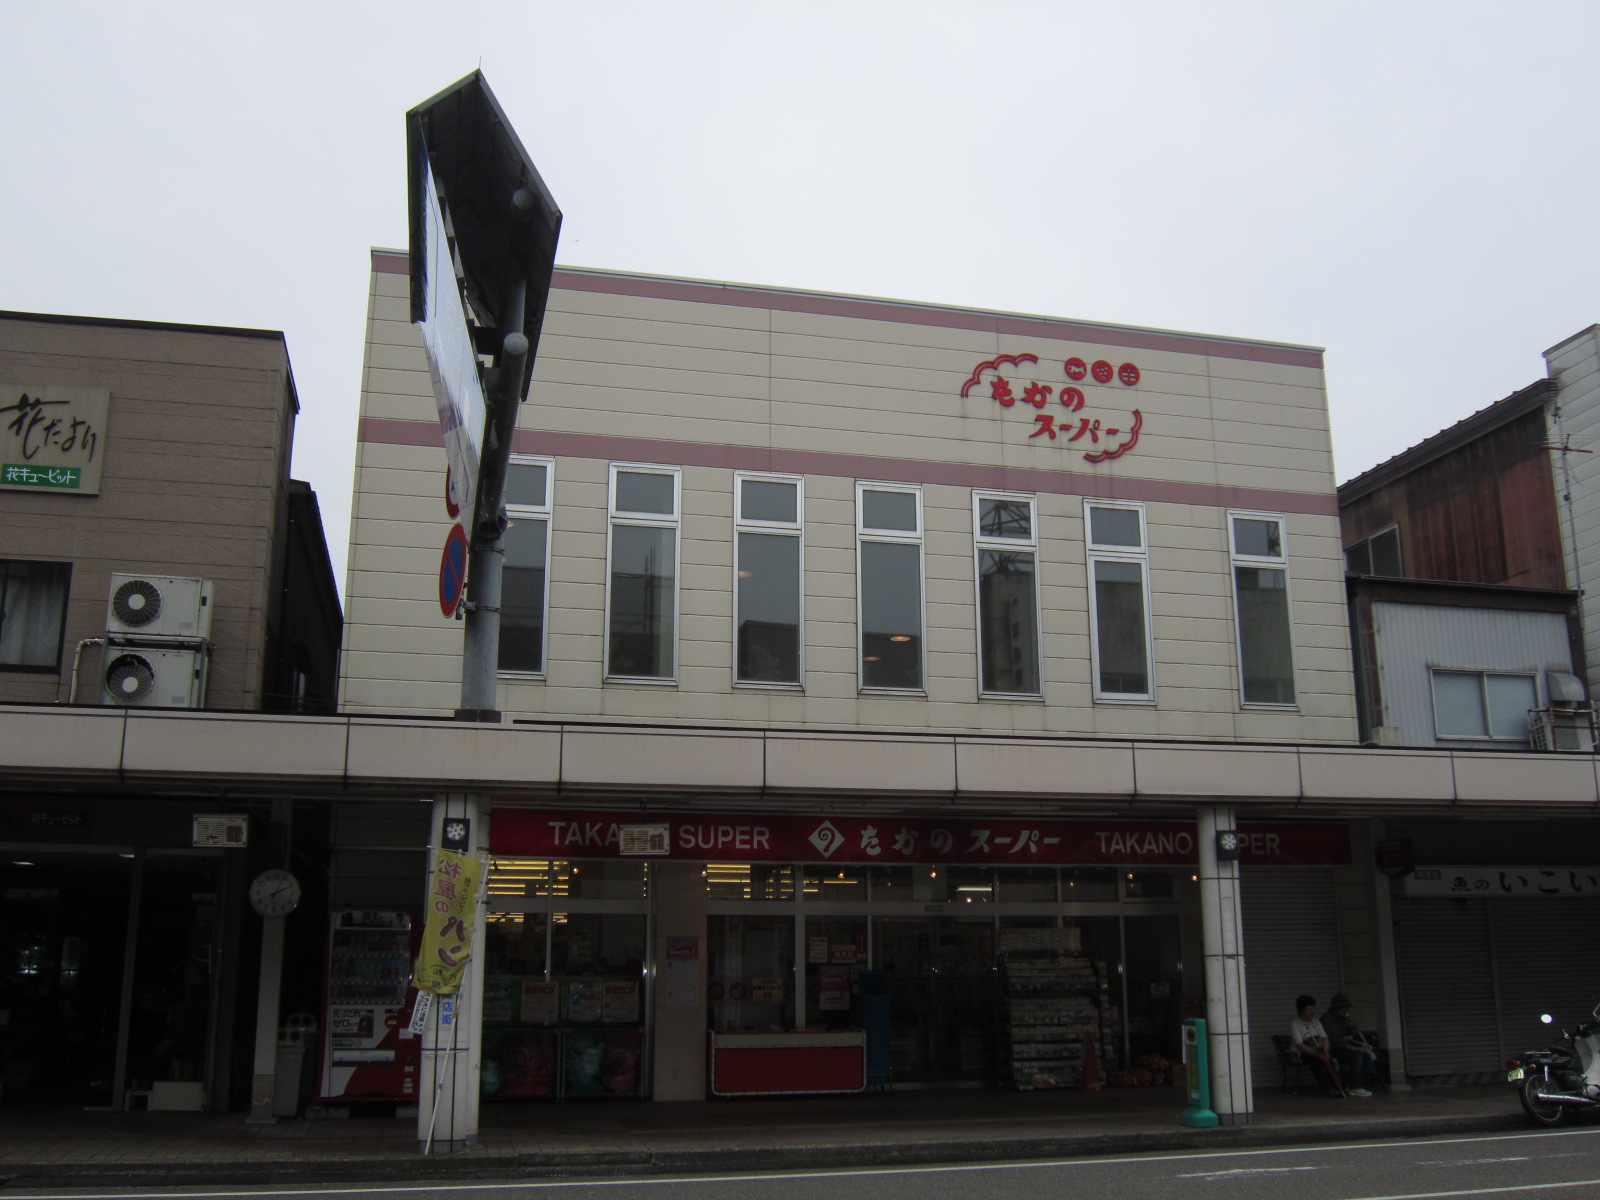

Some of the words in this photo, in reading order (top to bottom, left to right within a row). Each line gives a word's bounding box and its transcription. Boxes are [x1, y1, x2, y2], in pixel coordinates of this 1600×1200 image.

[0, 393, 97, 463] 花だより
[1029, 414, 1120, 443] スーパー
[548, 821, 621, 846] TAKA
[678, 825, 770, 850] SUPER
[1095, 831, 1193, 854] TAKANO
[1238, 833, 1280, 855] PER
[1451, 870, 1598, 894] 魚のいこい
